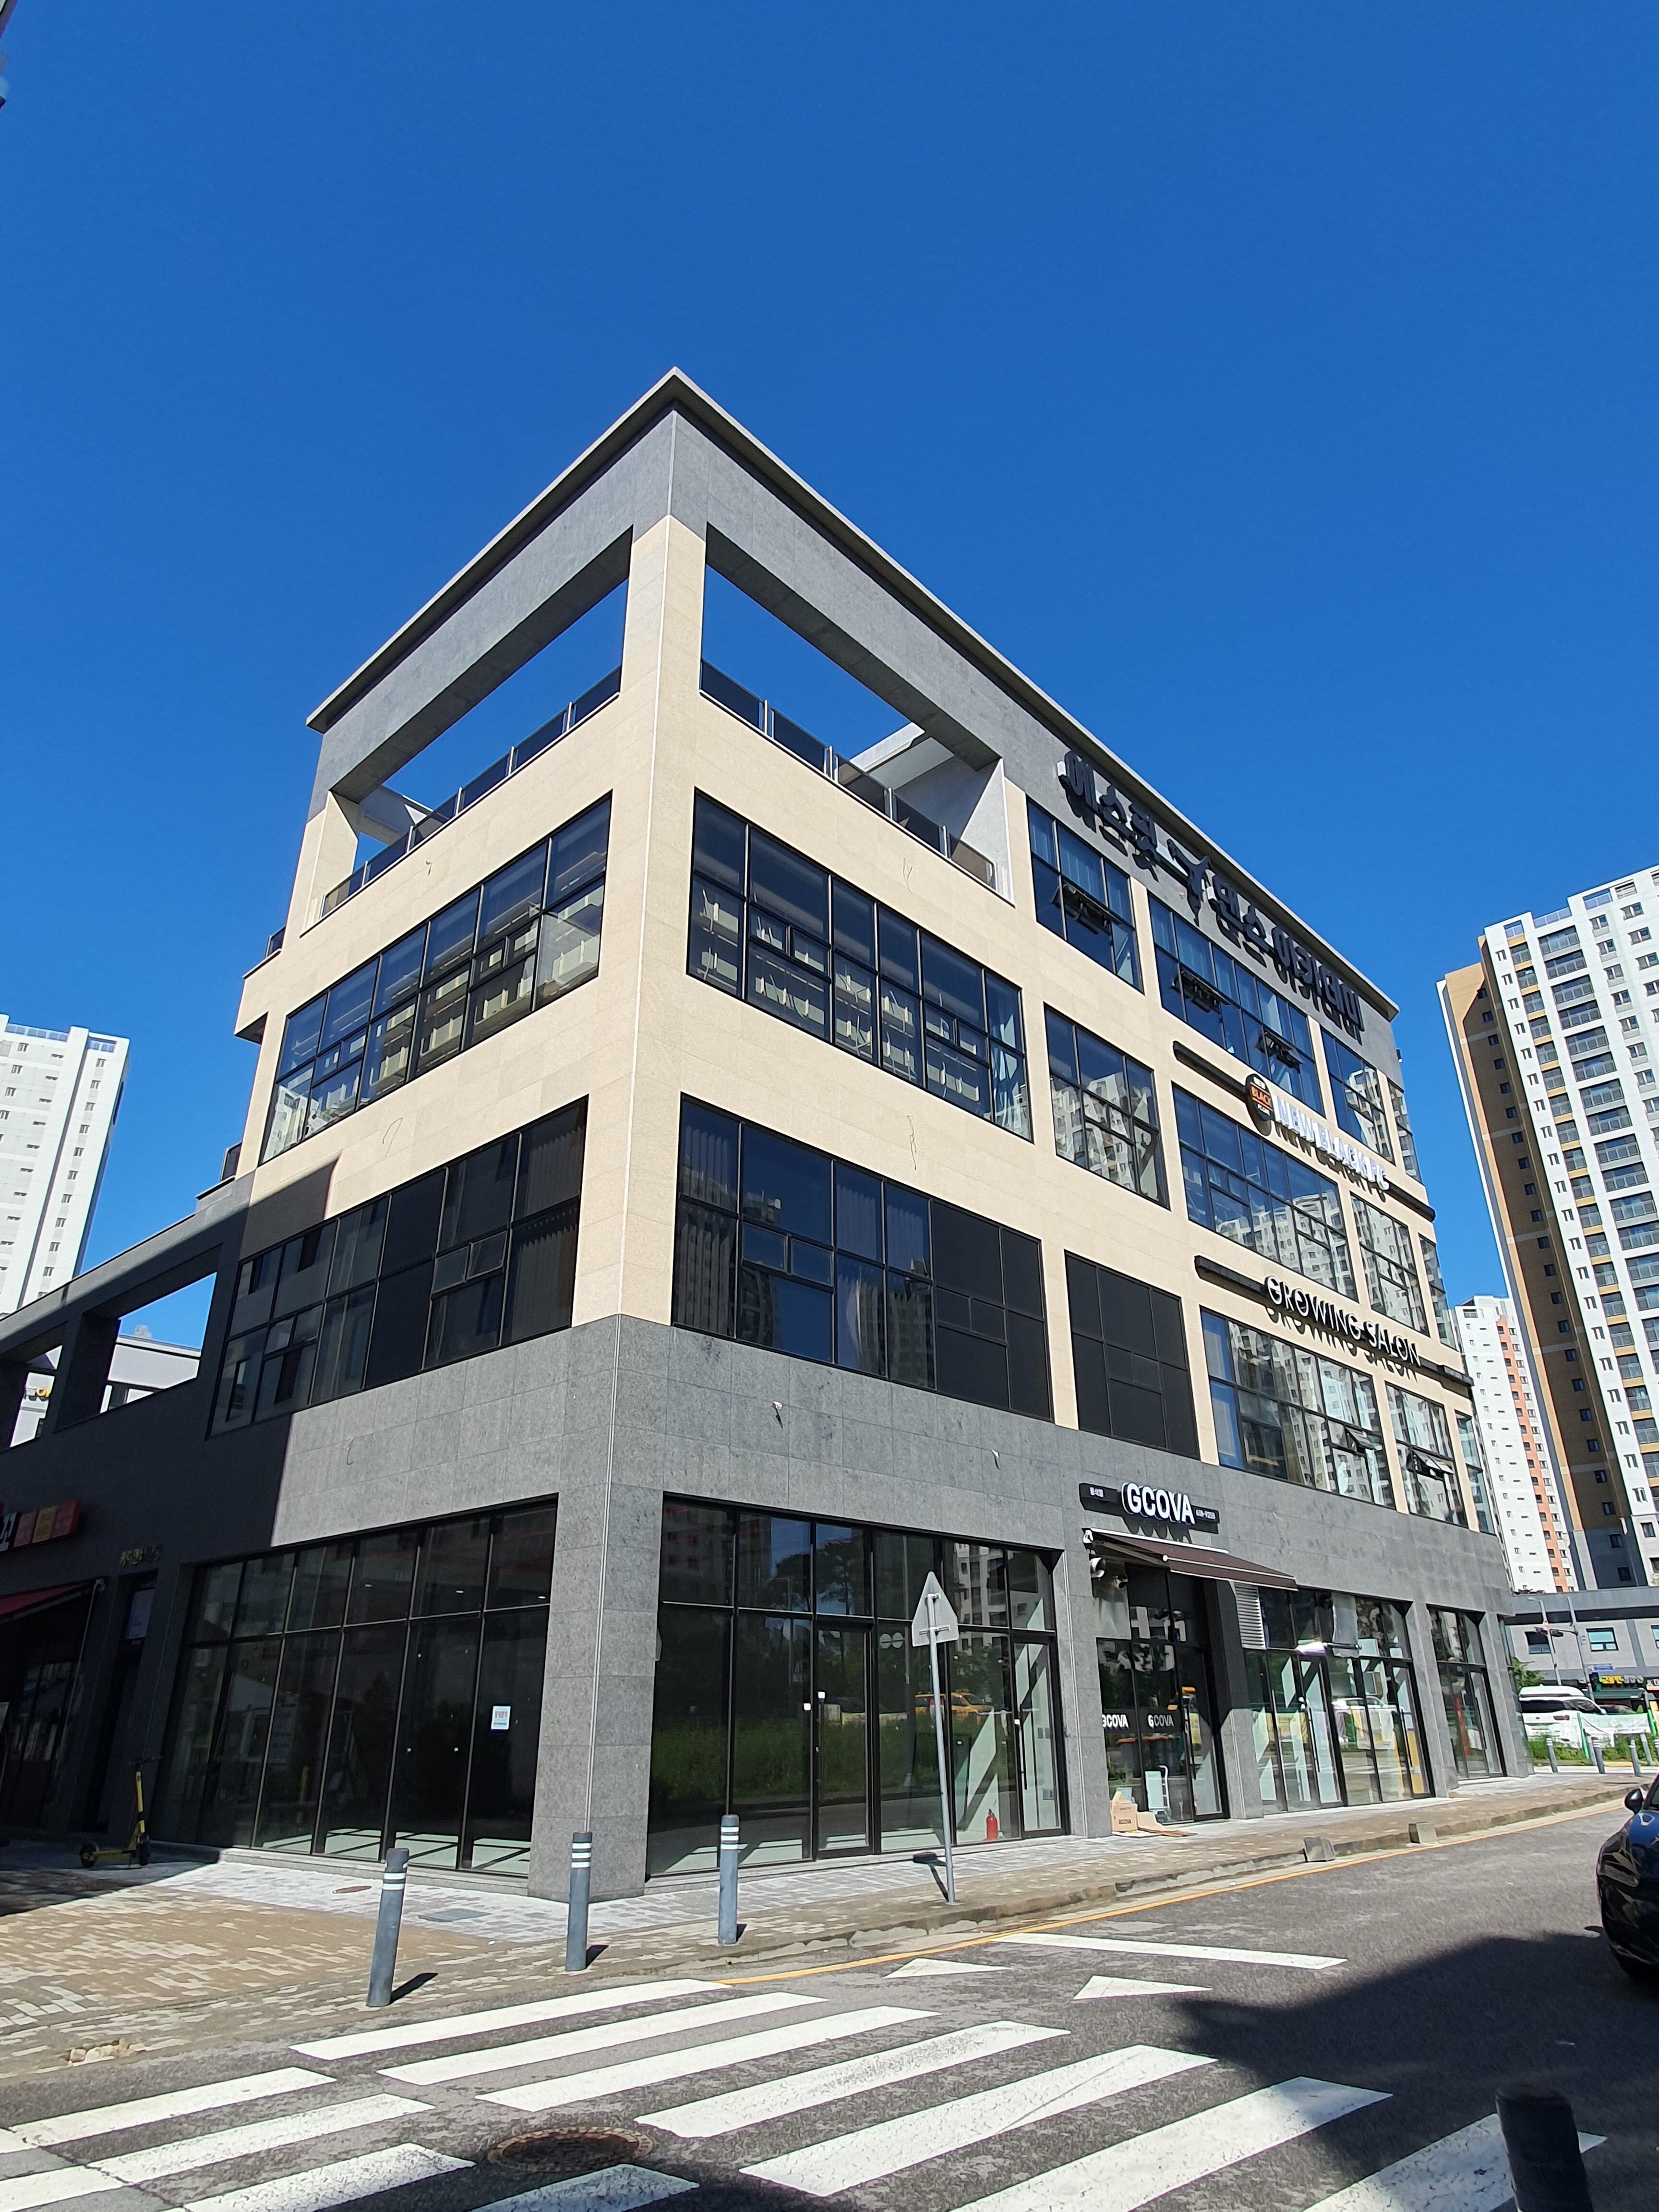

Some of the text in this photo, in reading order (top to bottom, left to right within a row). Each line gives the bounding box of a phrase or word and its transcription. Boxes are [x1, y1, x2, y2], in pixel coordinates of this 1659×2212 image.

[1272, 1095, 1390, 1190] NEW BLACK PC
[1265, 1276, 1421, 1367] GROWING SALON
[1126, 1482, 1195, 1524] GCOVA
[1148, 1714, 1174, 1728] GCOVA
